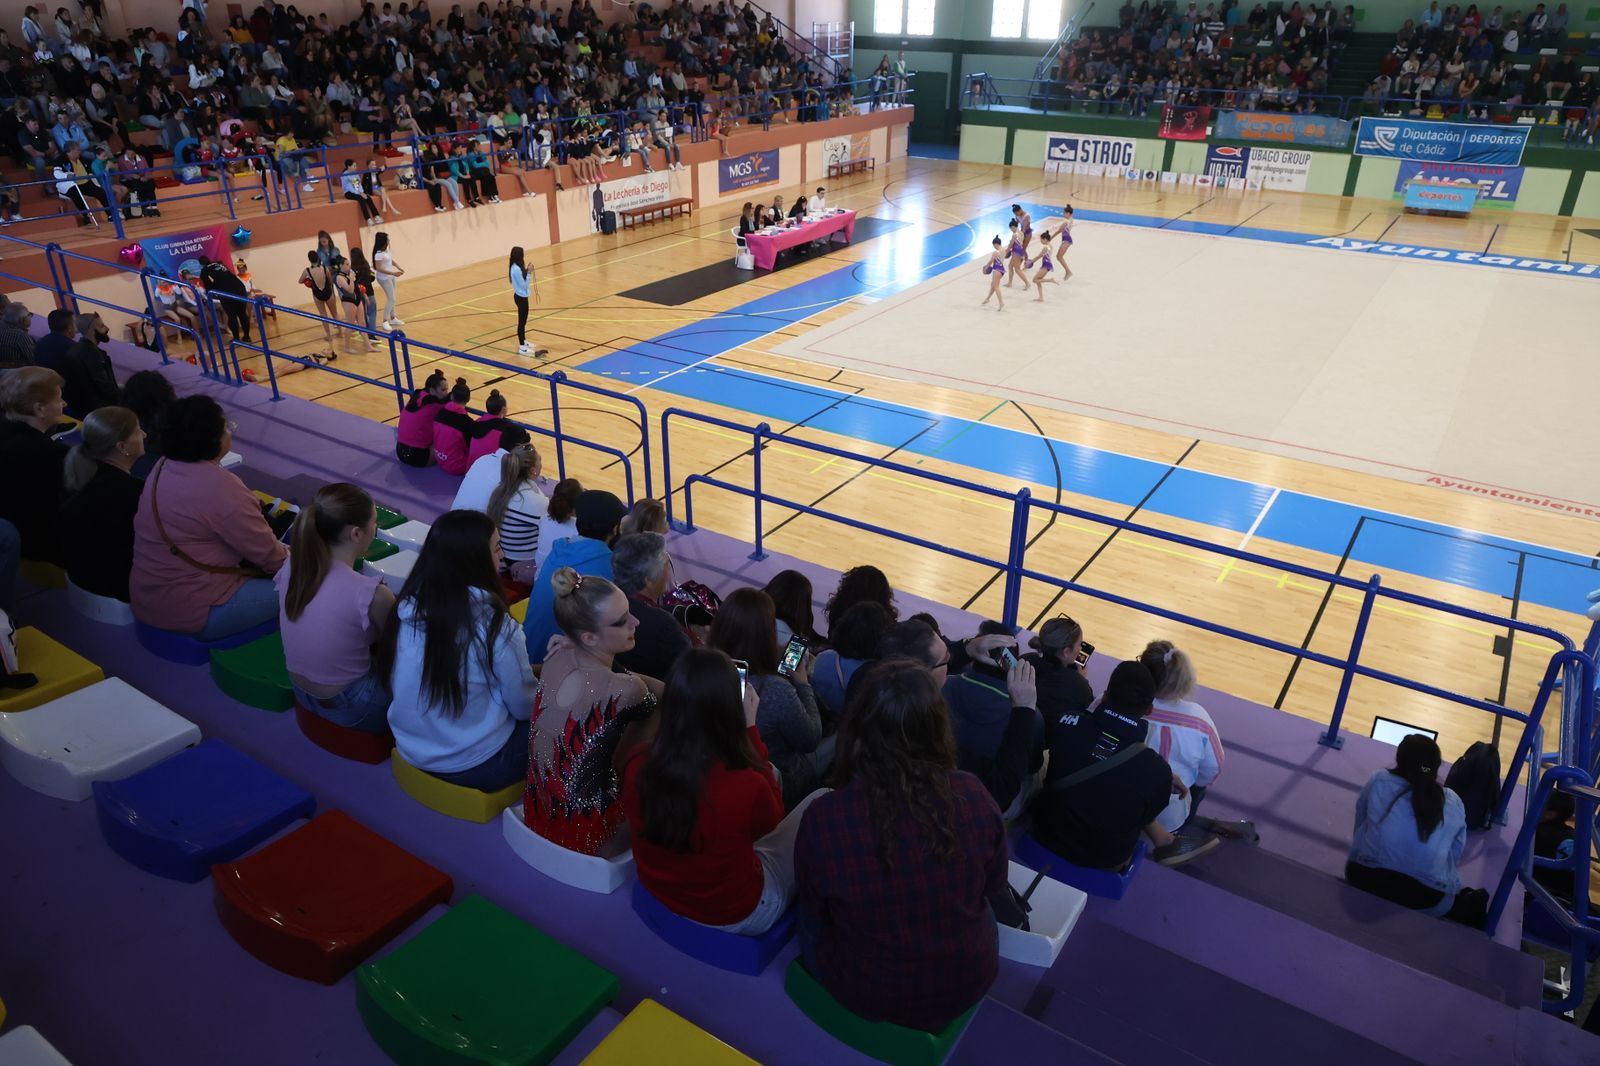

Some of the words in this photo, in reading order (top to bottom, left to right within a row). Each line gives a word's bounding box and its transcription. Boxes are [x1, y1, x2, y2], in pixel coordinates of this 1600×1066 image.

[1403, 128, 1460, 142] Diputación
[1469, 134, 1523, 144] DEPORTES
[1080, 139, 1133, 166] STROG
[1251, 149, 1280, 163] UBAGO
[1281, 151, 1312, 165] GROUP
[1401, 143, 1413, 152] de
[1416, 143, 1446, 155] Cádiz
[729, 161, 752, 178] MGS
[1208, 162, 1242, 179] UBAGO
[604, 191, 612, 202] La
[642, 184, 649, 194] de
[650, 181, 668, 193] Diego
[169, 248, 180, 256] LA
[1306, 237, 1600, 274] Ayuntami
